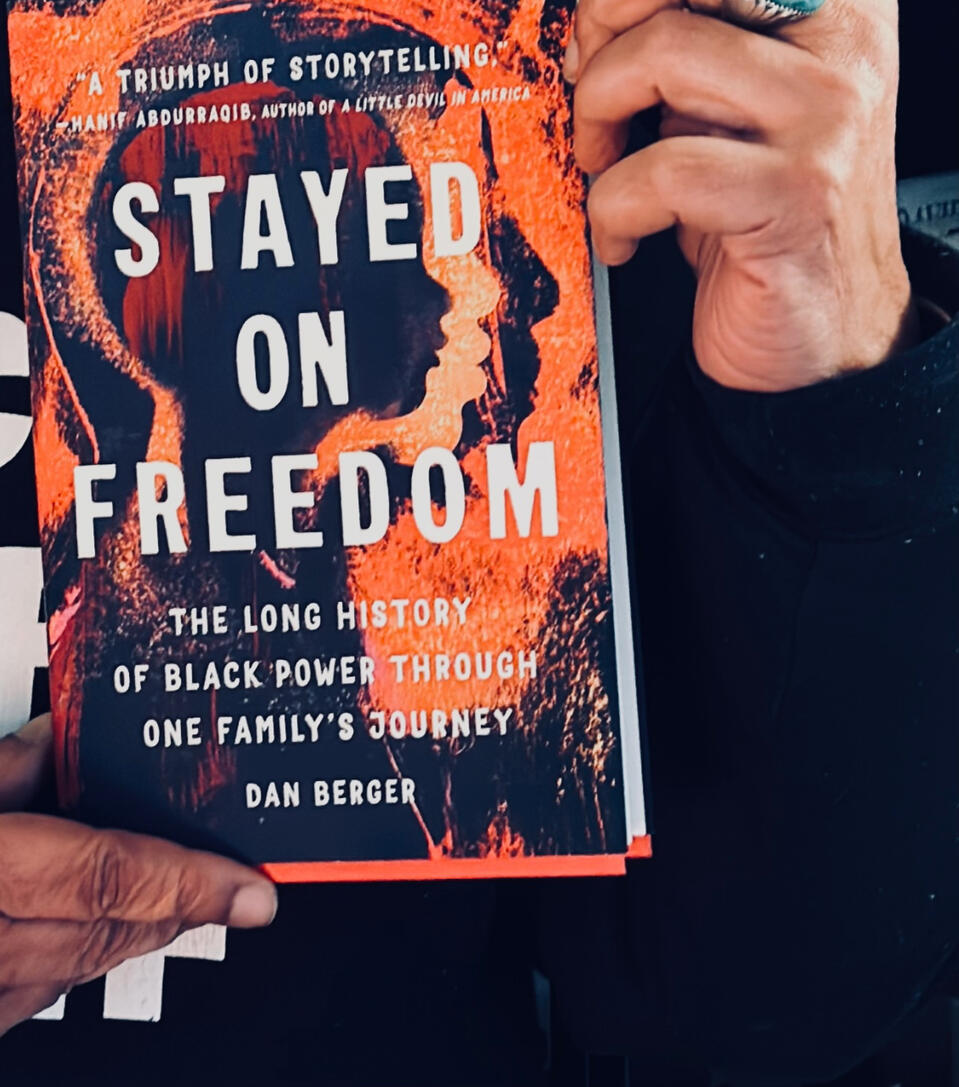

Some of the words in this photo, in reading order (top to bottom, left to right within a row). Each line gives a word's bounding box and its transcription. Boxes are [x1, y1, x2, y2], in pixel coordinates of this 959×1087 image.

[76, 70, 103, 97] "A
[116, 60, 230, 95] TRIUMPH
[243, 57, 276, 85] OF
[135, 102, 257, 129] ABDURRAQIB,
[261, 100, 314, 119] AUTHOR
[318, 98, 336, 116] OF
[341, 96, 351, 113] A
[355, 93, 403, 112] LITTLE
[407, 90, 446, 109] DEVIL
[451, 89, 466, 106] IN
[471, 85, 531, 103] AMERICA
[112, 161, 482, 278] STAYED
[235, 310, 349, 412] ON
[73, 441, 559, 559] FREEDOM
[168, 605, 229, 637] THE
[243, 601, 322, 634] LONG
[337, 596, 473, 631] HISTORY
[113, 664, 150, 694] OF
[164, 660, 263, 692] BLACK
[275, 655, 376, 688] POWER
[388, 649, 539, 684] THROUGH
[142, 717, 202, 748] ONE
[216, 712, 356, 746] FAMILY'S
[369, 707, 514, 741] JOURNEY
[245, 780, 301, 809] DAN
[313, 777, 417, 807] BERGER
